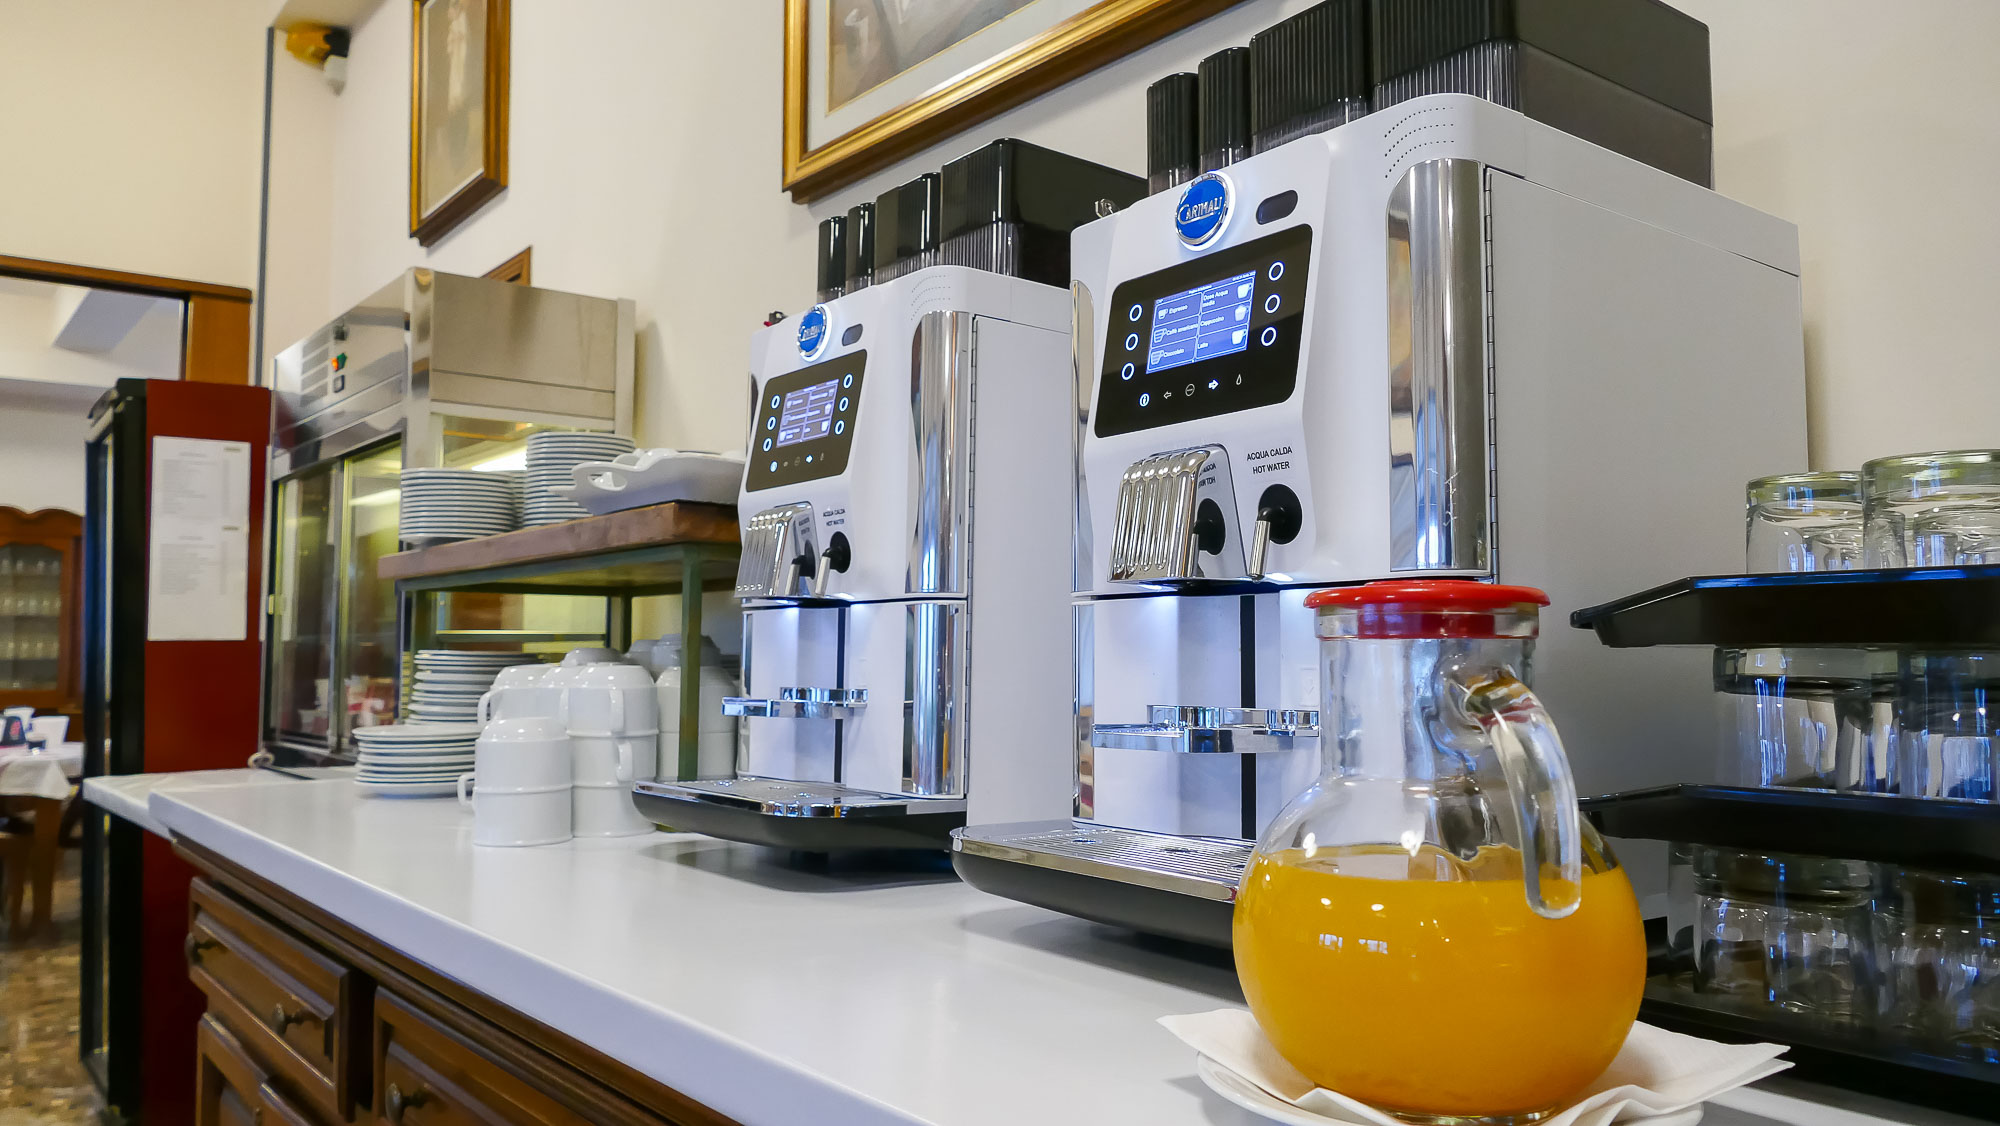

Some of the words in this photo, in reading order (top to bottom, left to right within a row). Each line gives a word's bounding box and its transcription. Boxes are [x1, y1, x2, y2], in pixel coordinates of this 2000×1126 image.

[1177, 196, 1223, 225] CARIMALI
[1246, 449, 1269, 461] ACQUA
[1270, 446, 1293, 457] CALDA
[1252, 465, 1266, 474] HOT
[1266, 461, 1290, 472] WATER
